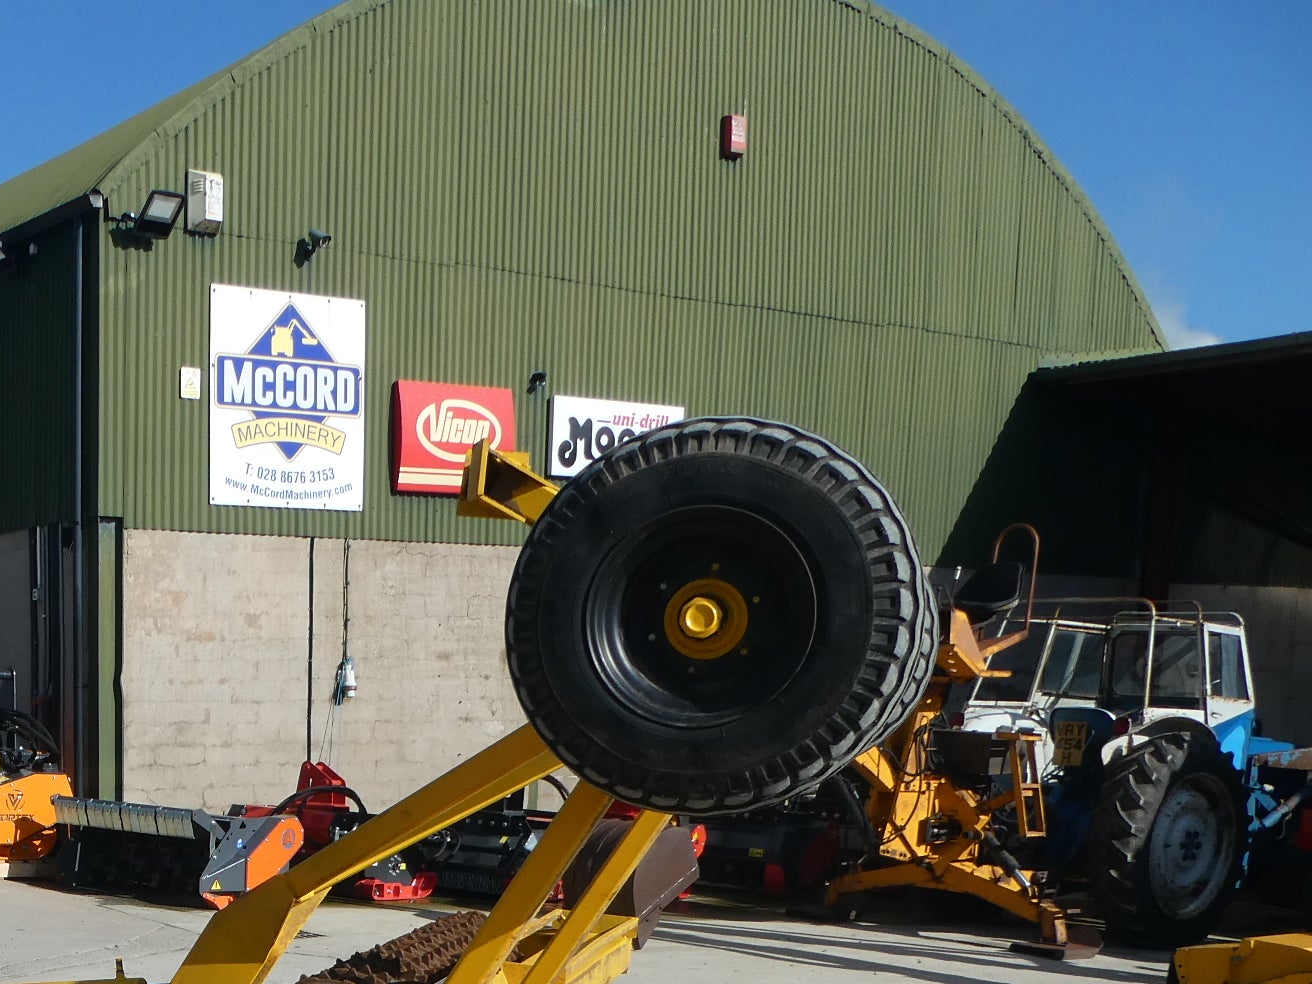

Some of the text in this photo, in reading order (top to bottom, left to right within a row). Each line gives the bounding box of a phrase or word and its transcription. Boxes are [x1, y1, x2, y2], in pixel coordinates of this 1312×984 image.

[429, 402, 491, 445] Vicon
[612, 412, 669, 430] uni-drill
[237, 421, 342, 448] MACHINERY
[245, 462, 335, 484] T: 028 8676 3153
[224, 475, 353, 500] www.McCordMachinery.com
